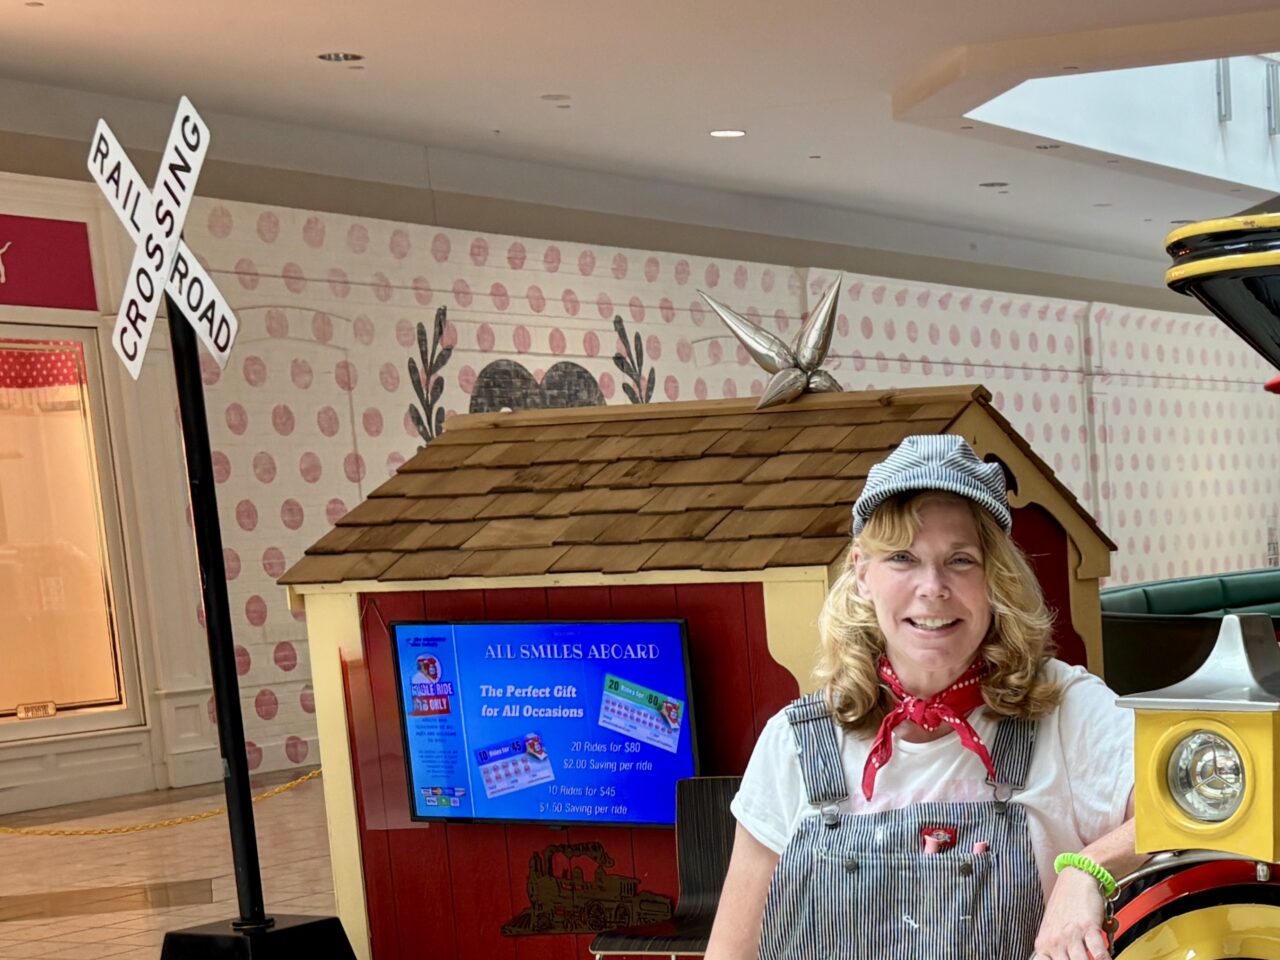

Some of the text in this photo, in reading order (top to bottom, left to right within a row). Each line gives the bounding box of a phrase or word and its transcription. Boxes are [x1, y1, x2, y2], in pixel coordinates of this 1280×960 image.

[92, 132, 233, 354] RAIL ROAD
[119, 115, 202, 363] CROSSING
[485, 643, 660, 659] ALL SMILES ABOARD
[480, 685, 577, 698] The Perfect Gift
[608, 679, 620, 691] 20
[481, 704, 584, 718] for All Occasions
[571, 741, 641, 753] 20 Rides for $80
[563, 759, 653, 772] $2.00 Saving per ride
[585, 786, 597, 796] for
